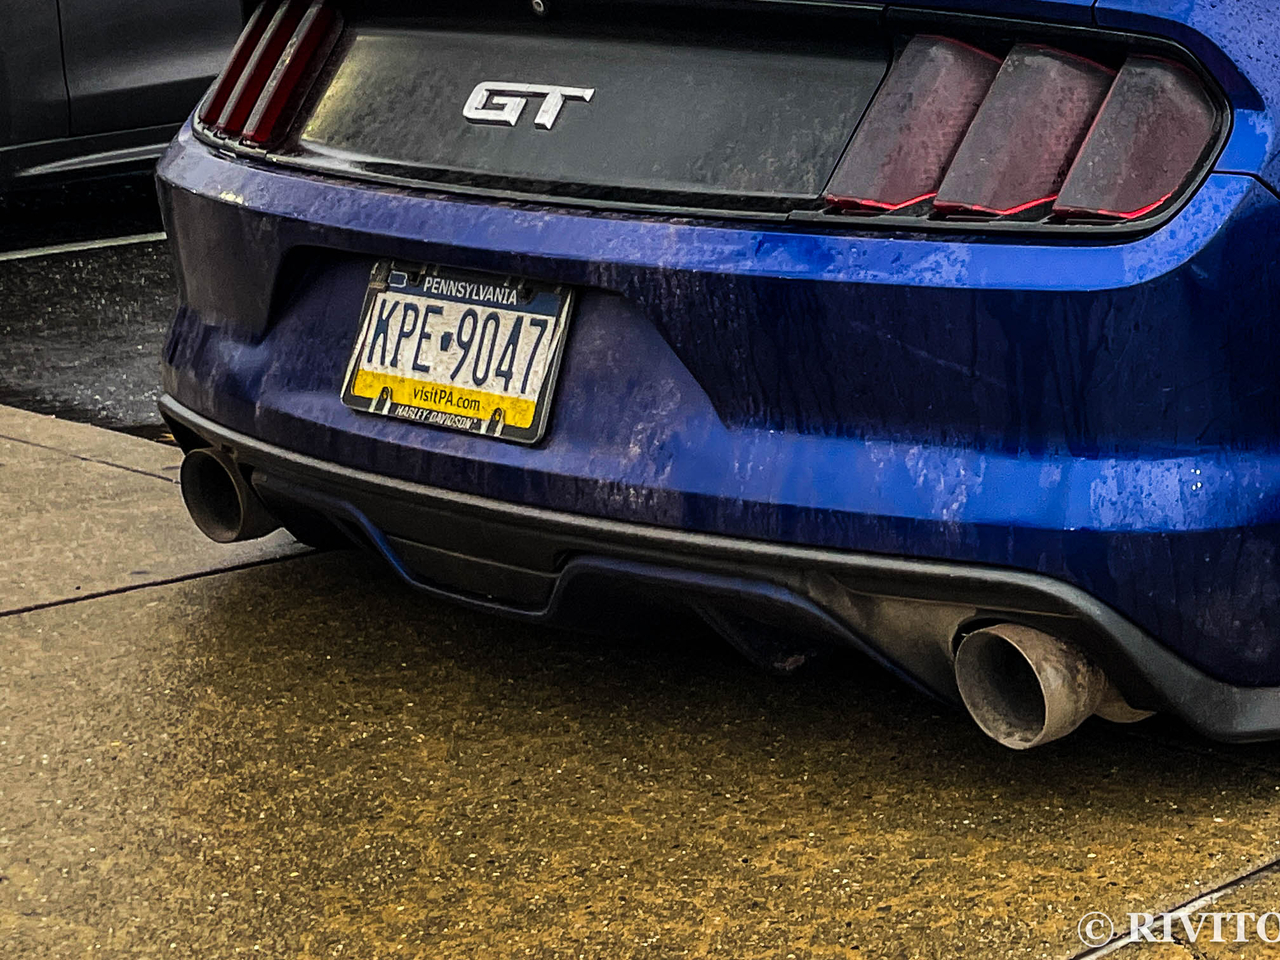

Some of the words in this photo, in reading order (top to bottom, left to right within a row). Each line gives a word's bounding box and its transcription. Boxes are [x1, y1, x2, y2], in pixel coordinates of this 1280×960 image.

[462, 81, 596, 130] GT
[423, 276, 518, 306] PENNSYLVANIA
[413, 387, 481, 412] visitPA.com
